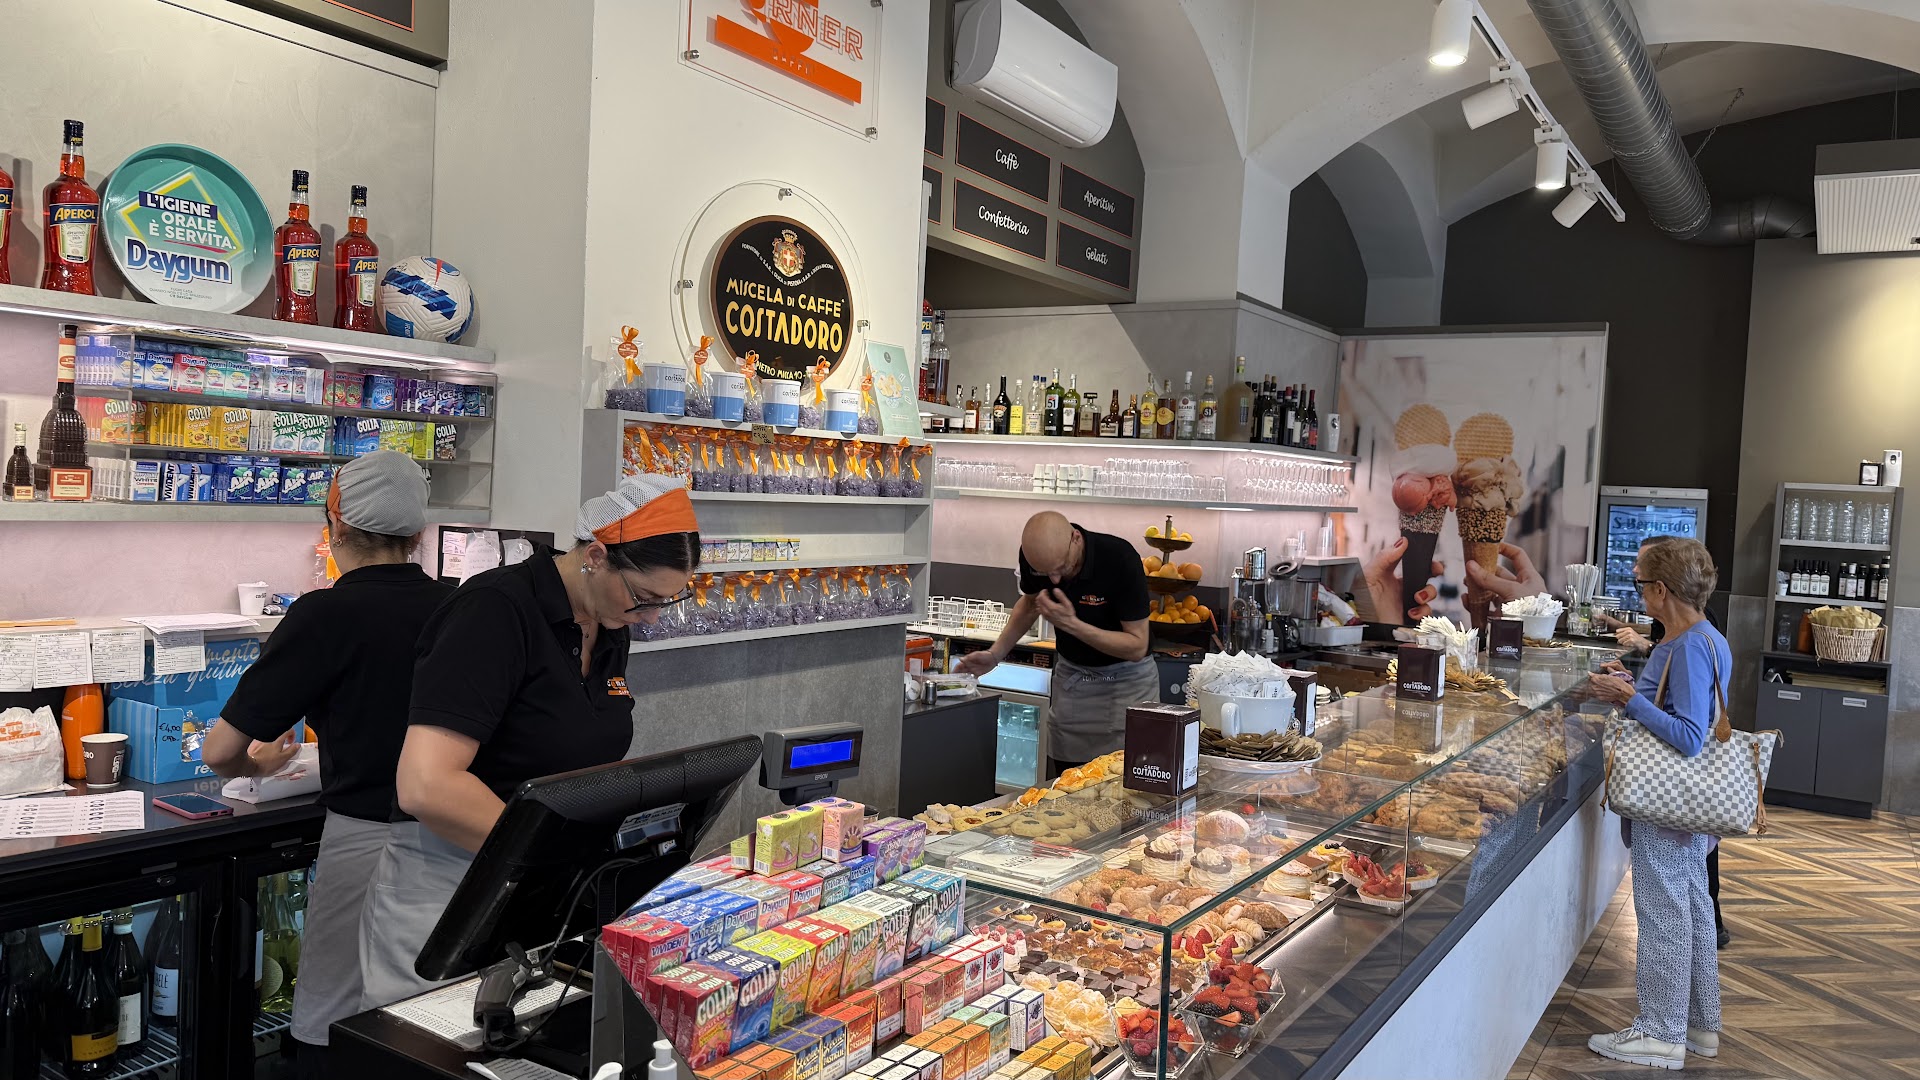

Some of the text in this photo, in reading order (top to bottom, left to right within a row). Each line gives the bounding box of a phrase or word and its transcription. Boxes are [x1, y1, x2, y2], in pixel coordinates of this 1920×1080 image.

[995, 148, 1020, 171] Caffè
[146, 193, 211, 218] L'IGIENE
[1083, 190, 1116, 214] Aperitivi
[54, 207, 96, 221] APEROL
[160, 212, 217, 233] ORALE
[978, 205, 1029, 236] Confetteria
[149, 219, 237, 250] È SERVITA.
[125, 236, 232, 284] Daygum
[1085, 247, 1109, 265] Gelati
[726, 277, 784, 305] MISCELA
[787, 295, 795, 308] DI
[726, 300, 843, 353] COSTADORO
[418, 390, 434, 399] ICE
[439, 391, 453, 400] ICE
[1047, 399, 1057, 409] 51
[224, 407, 249, 423] GOLIA
[275, 414, 299, 427] GOLIA
[303, 415, 325, 429] GOLIA
[357, 418, 379, 433] GOLIA
[436, 424, 457, 438] GOLIA
[165, 463, 175, 500] VIVIDENT
[188, 464, 197, 500] VIVIDENT
[228, 471, 254, 492] AIR
[255, 472, 279, 493] AIR
[282, 472, 306, 493] AIR
[307, 471, 325, 481] AIR
[1403, 682, 1431, 692] COSTADORO
[815, 773, 828, 781] EPSON
[1132, 767, 1171, 780] COSTADORO
[762, 897, 788, 913] Daygum
[793, 885, 821, 904] Daygum
[726, 909, 757, 929] Daygum
[914, 894, 939, 926] GOLIA
[692, 919, 723, 941] VIVIDENT
[851, 920, 878, 956] GOLIA
[652, 936, 687, 957] VIVIDENT
[816, 932, 845, 972] GOLIA
[781, 948, 813, 989] GOLIA
[740, 963, 777, 1007] GOLIA
[696, 981, 735, 1026] GOLIA
